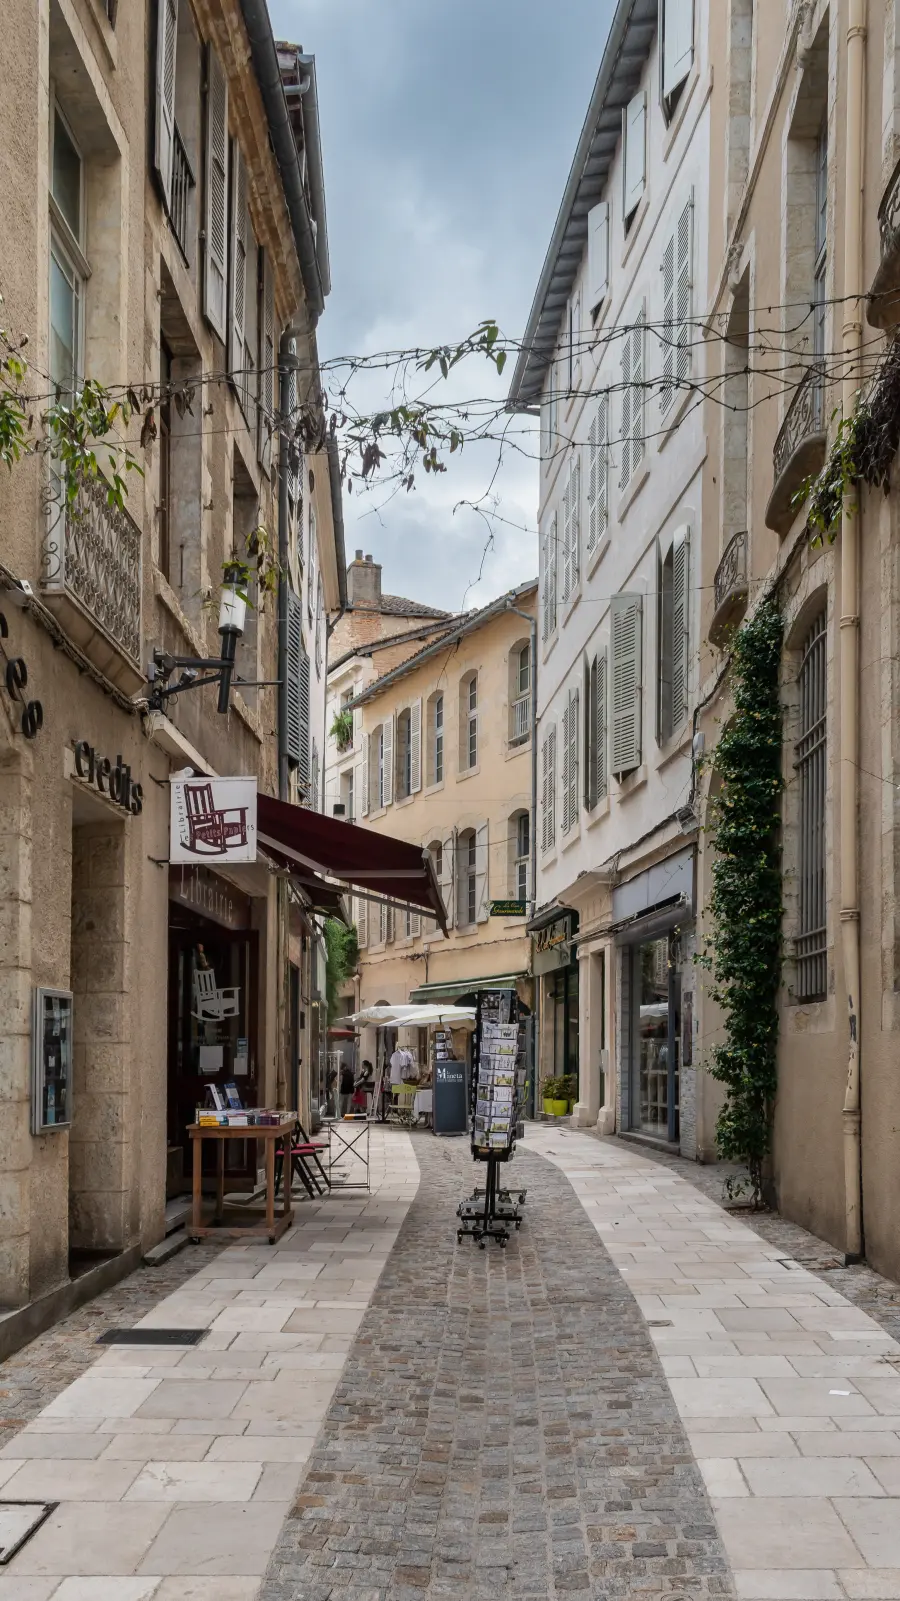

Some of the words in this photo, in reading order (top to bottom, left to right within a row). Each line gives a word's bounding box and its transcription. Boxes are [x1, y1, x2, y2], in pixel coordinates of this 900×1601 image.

[175, 784, 186, 834] Librairie
[195, 827, 221, 840] Petits
[179, 863, 233, 923] Librairie
